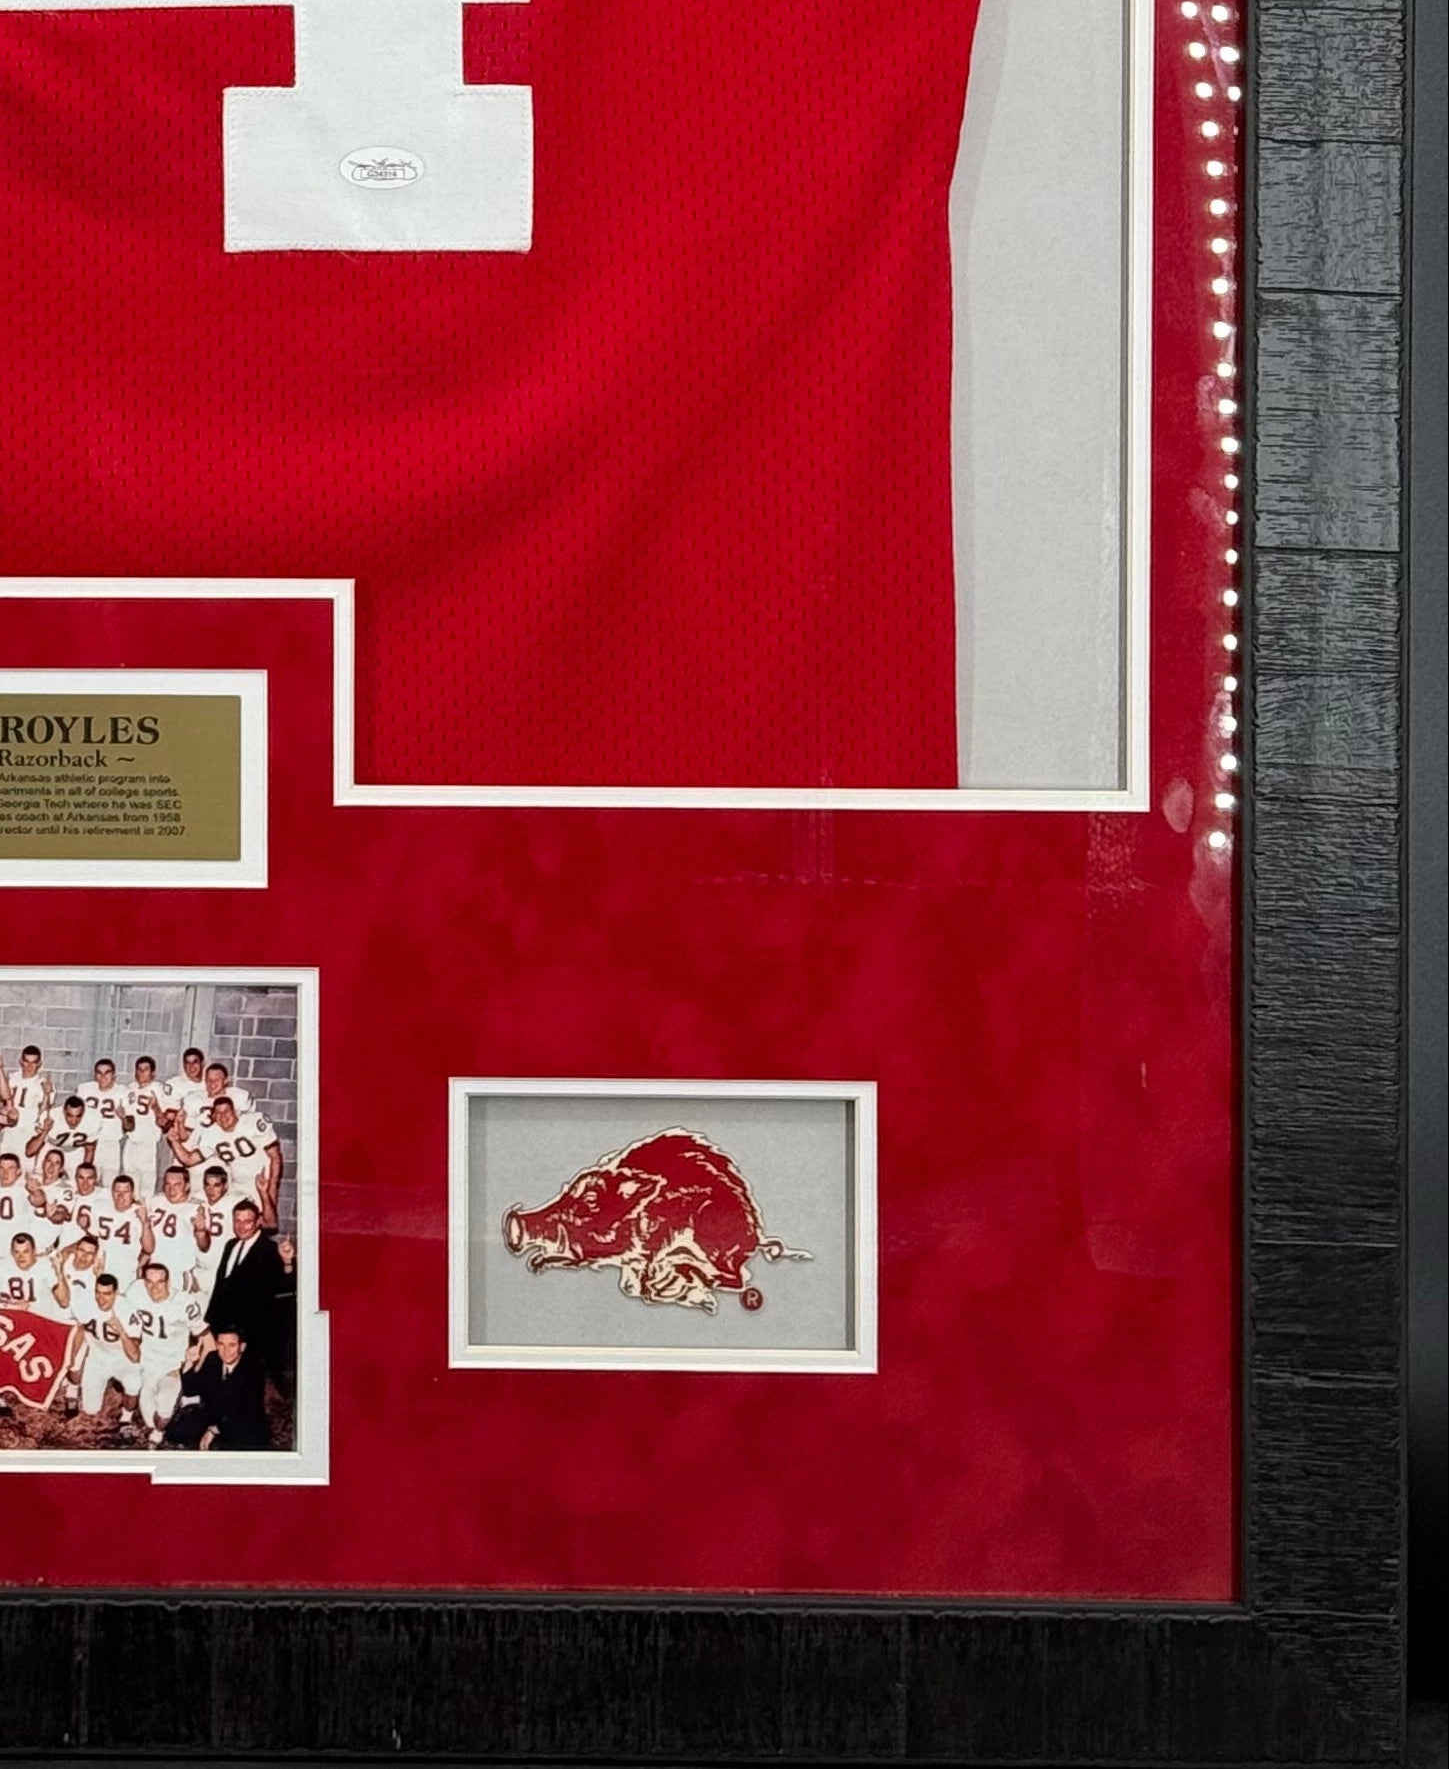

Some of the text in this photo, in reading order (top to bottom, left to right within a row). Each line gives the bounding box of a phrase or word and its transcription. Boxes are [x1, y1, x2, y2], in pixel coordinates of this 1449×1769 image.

[54, 771, 97, 782] athletic
[97, 775, 147, 785] program
[148, 772, 171, 783] into
[67, 784, 83, 795] all
[97, 785, 141, 798] college
[43, 797, 72, 808] Tech
[72, 798, 110, 809] where
[129, 801, 153, 809] was
[155, 798, 183, 809] SEC
[14, 810, 51, 821] coach
[65, 811, 121, 822] Arkansas
[122, 811, 150, 822] from
[152, 811, 182, 822] 1958
[35, 823, 61, 834] until
[62, 823, 81, 834] his
[82, 824, 141, 835] retirement
[56, 1132, 88, 1147] 72
[216, 1136, 256, 1162] 60
[150, 1207, 177, 1238] 78
[98, 1216, 131, 1245] 54
[7, 1277, 37, 1304] 81
[137, 1309, 168, 1340] 21
